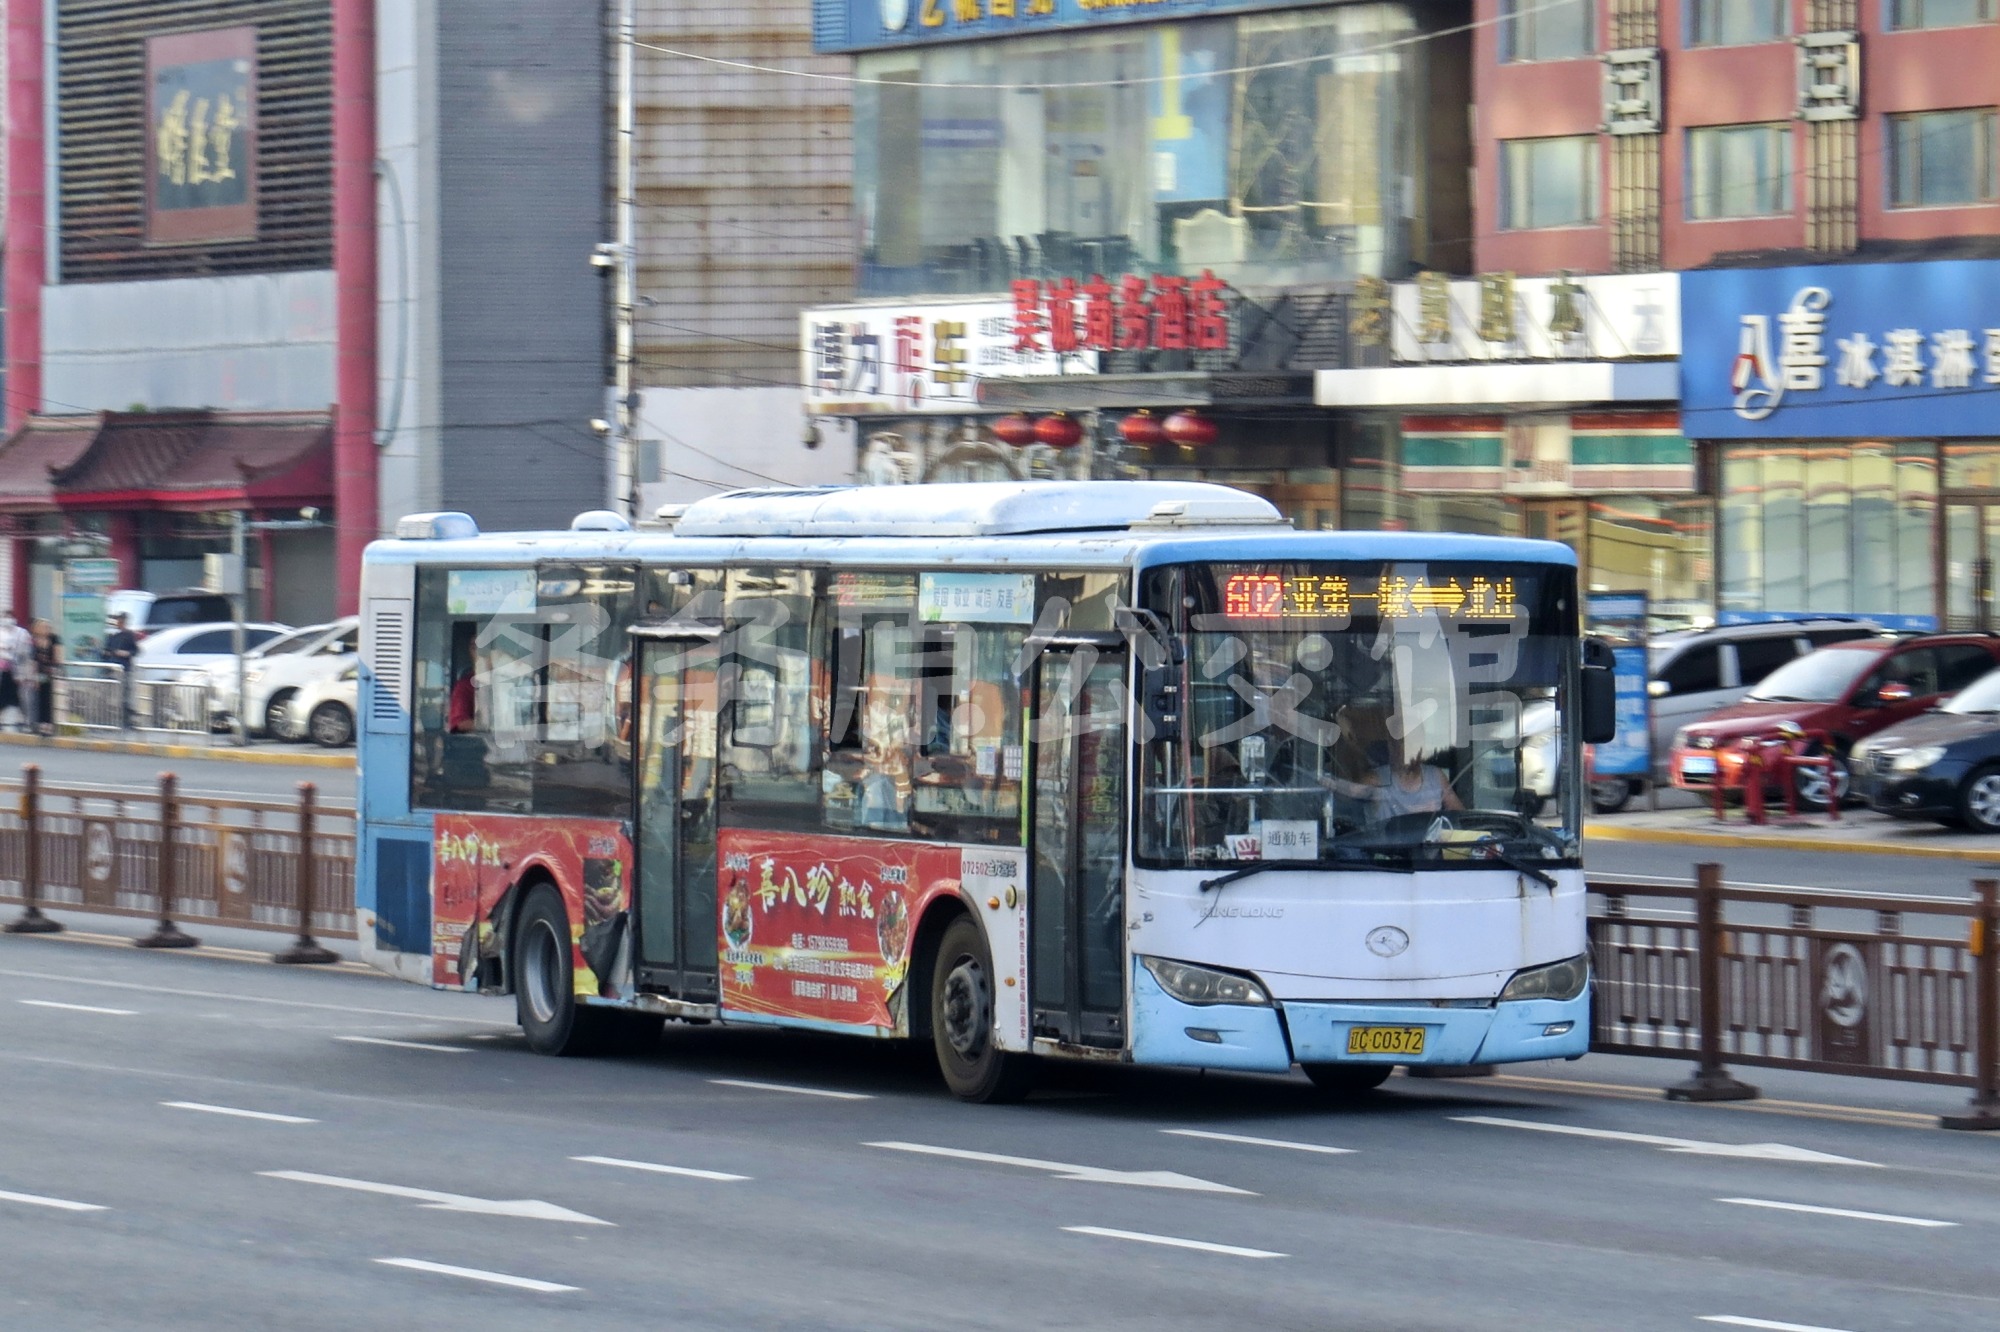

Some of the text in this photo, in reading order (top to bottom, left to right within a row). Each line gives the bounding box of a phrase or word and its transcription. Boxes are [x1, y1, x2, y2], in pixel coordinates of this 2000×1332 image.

[1731, 286, 1833, 420] 八喜
[933, 588, 949, 607] 爱国
[954, 588, 970, 608] 敬业
[975, 588, 991, 608] 诚信
[997, 588, 1014, 609] 友善
[1226, 574, 1282, 618] 602
[1267, 830, 1312, 847] 通勤车
[962, 861, 987, 876] 072502
[1240, 907, 1284, 919] LONG
